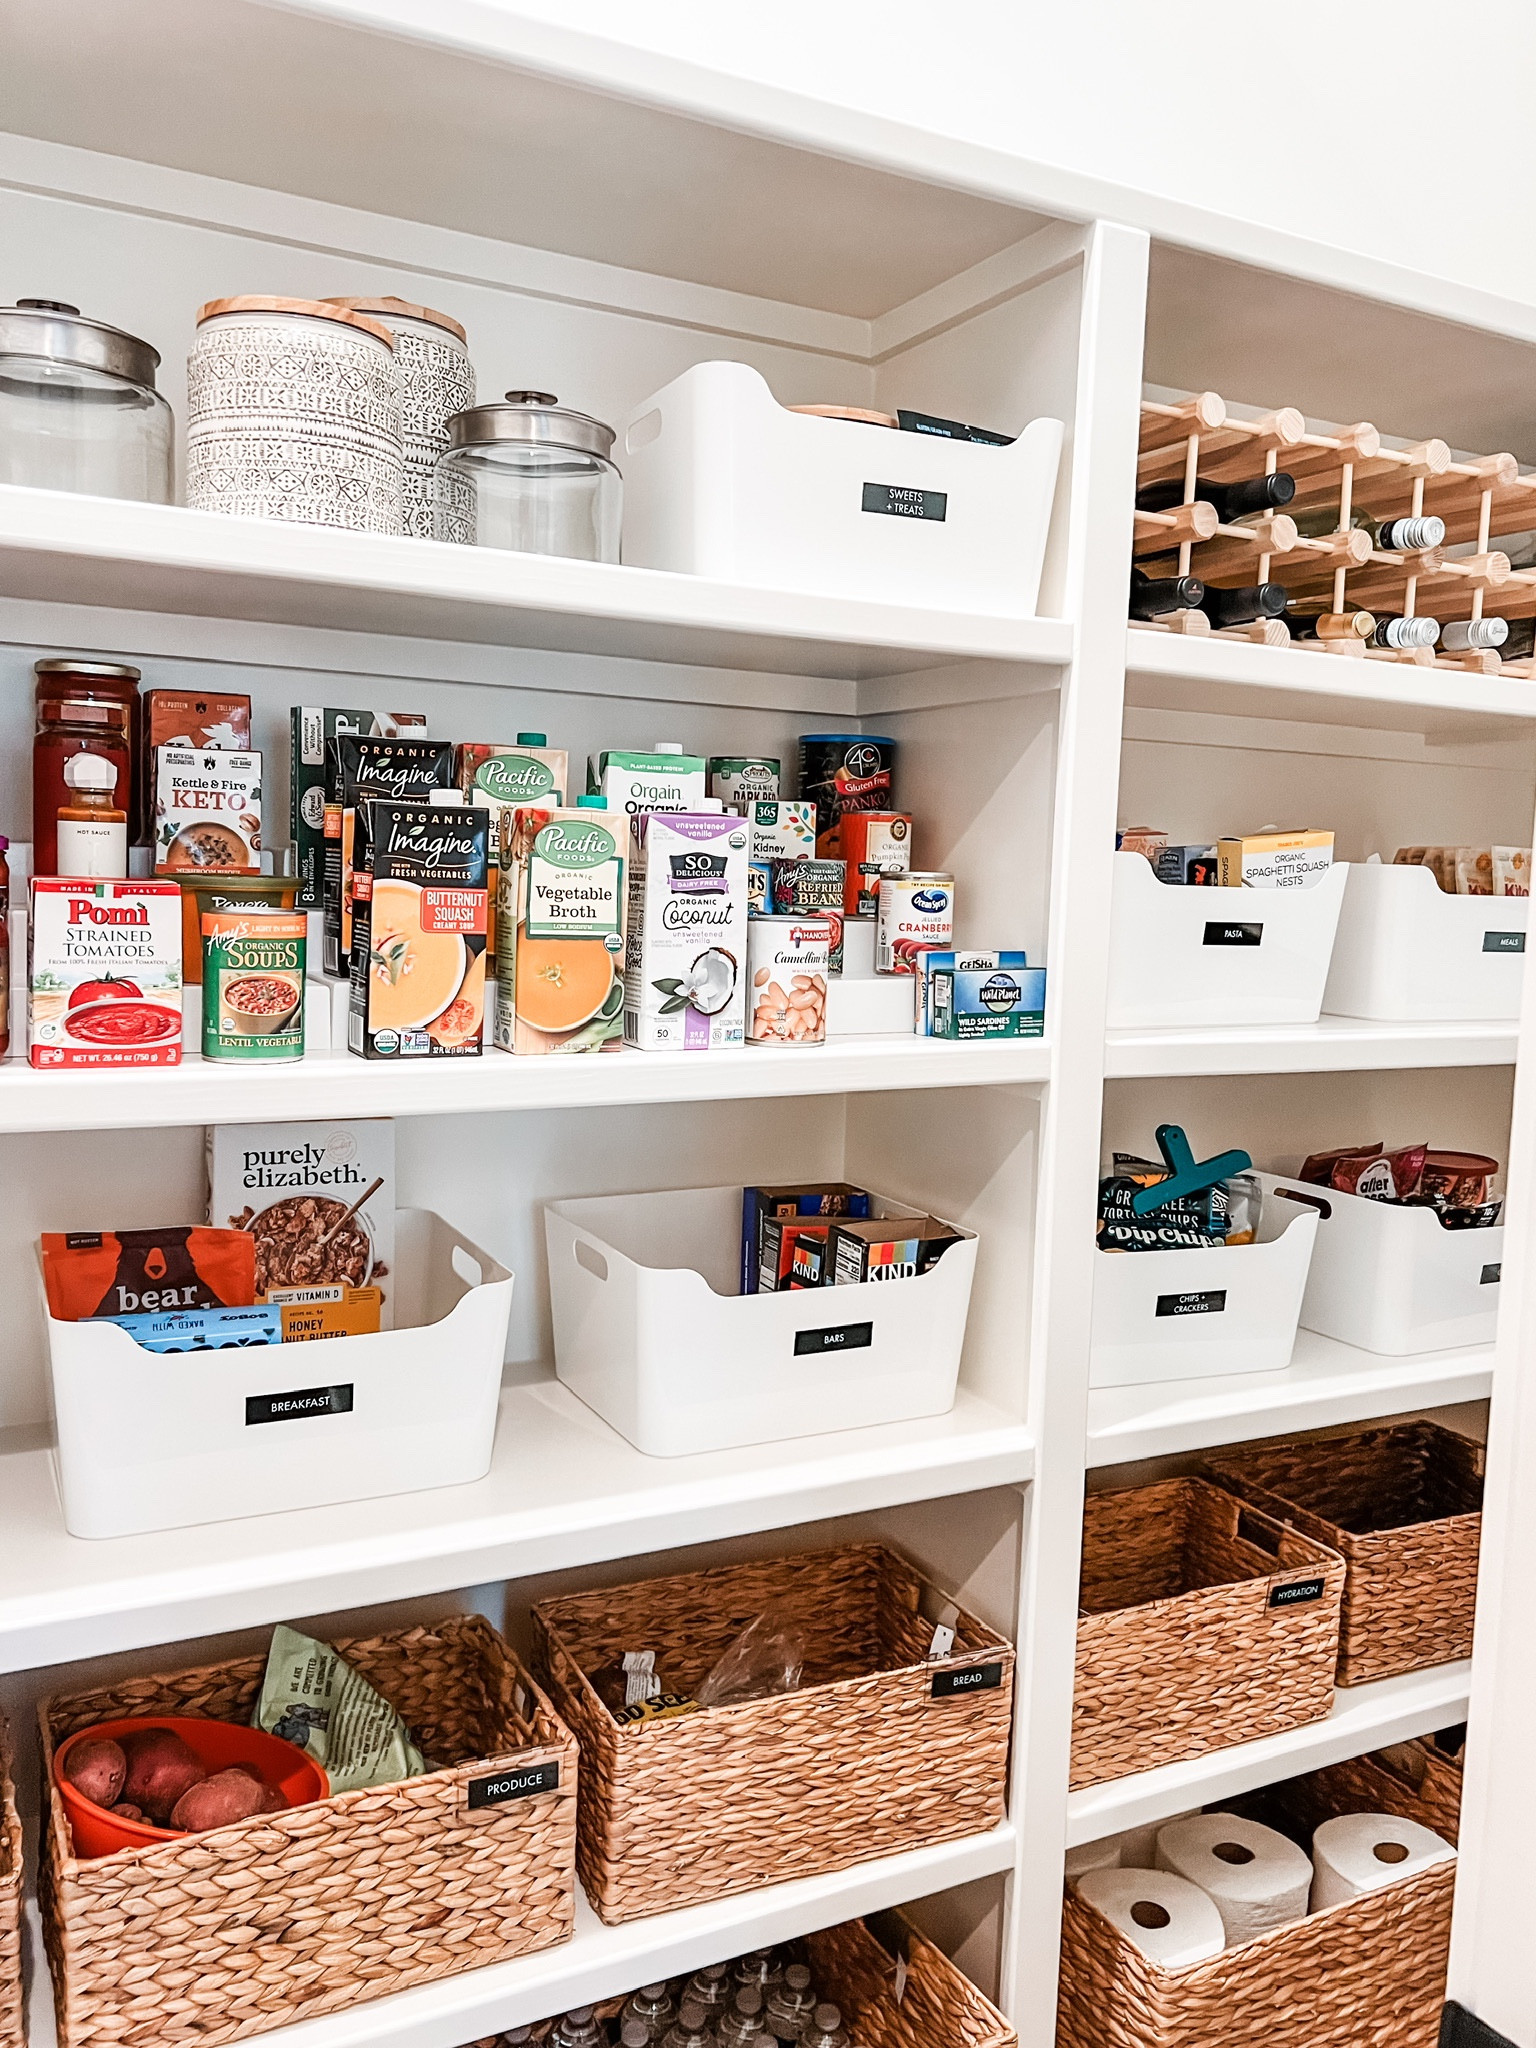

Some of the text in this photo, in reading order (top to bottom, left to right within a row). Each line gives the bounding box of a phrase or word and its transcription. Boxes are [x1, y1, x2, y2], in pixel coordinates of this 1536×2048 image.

[889, 488, 923, 502] SWEETS
[894, 503, 924, 516] TREATS
[360, 745, 436, 758] ORGANIC
[630, 763, 662, 771] PLANT-BASED
[483, 760, 548, 789] Pacific
[172, 778, 247, 790] Kettle & Fire
[498, 786, 532, 795] FOODS
[845, 777, 887, 792] Gluten Free
[630, 782, 681, 802] Orgain
[733, 790, 776, 800] DARK RED
[172, 790, 247, 811] KETO
[308, 795, 316, 817] Edward
[841, 791, 885, 811] PANKO
[392, 812, 473, 825] ORGANIC
[757, 806, 776, 818] 365
[675, 822, 725, 831] unsweetened
[541, 825, 609, 854] Pacific
[687, 830, 713, 838] vanilla
[753, 832, 776, 841] Organic
[753, 843, 785, 854] Kidney
[557, 854, 592, 862] FOODS
[685, 856, 711, 869] SO
[1274, 852, 1306, 863] ORGANIC
[390, 868, 472, 879] FRESH VEGETABLES
[675, 869, 721, 877] DELICIOUS
[1246, 860, 1329, 879] SPAGHETTI SQUASH
[555, 872, 593, 881] ORGANIC
[774, 865, 808, 892] Amy's
[807, 874, 839, 882] ORGANIC
[1276, 875, 1304, 887] NESTS
[798, 881, 843, 892] REFRIED
[302, 893, 315, 901] 8
[426, 891, 484, 907] BUTTERNUT
[536, 885, 612, 903] Vegetable
[797, 892, 843, 905] BEANS
[913, 896, 946, 910] Ocean Spray
[434, 907, 474, 922] SQUASH
[549, 904, 597, 918] Broth
[662, 900, 734, 930] Coconut
[66, 928, 152, 943] STRAINED
[207, 921, 251, 956] Amy's
[1224, 929, 1243, 939] PASTA
[245, 942, 283, 951] ORGANIC
[1500, 938, 1519, 946] MEALS
[62, 942, 154, 958] TOMATOES
[227, 942, 298, 968] SOUPS
[960, 959, 993, 969] GEISHA
[981, 988, 1020, 1000] Wild Planet
[958, 1018, 976, 1026] WILD
[977, 1016, 1010, 1025] SARDINES
[657, 1029, 669, 1038] 50
[219, 1036, 254, 1047] LENTIL
[72, 1054, 87, 1062] NET
[243, 1143, 326, 1171] purely
[1108, 1225, 1157, 1244] Dip
[792, 1260, 819, 1281] KIND
[867, 1261, 916, 1282] KIND
[116, 1284, 198, 1312] bear
[296, 1290, 330, 1301] VITAMIN
[333, 1289, 339, 1298] D
[1179, 1295, 1199, 1303] CHIPS
[1173, 1303, 1209, 1313] CRACKERS
[152, 1322, 175, 1331] WITH
[289, 1319, 323, 1332] HONEY
[309, 1330, 347, 1341] BUTTER
[824, 1333, 844, 1344] BARS
[271, 1396, 330, 1413] BREAKFAST
[1278, 1586, 1319, 1600] HYDRATION
[953, 1673, 982, 1686] BREAD
[487, 1773, 543, 1796] PRODUCE
